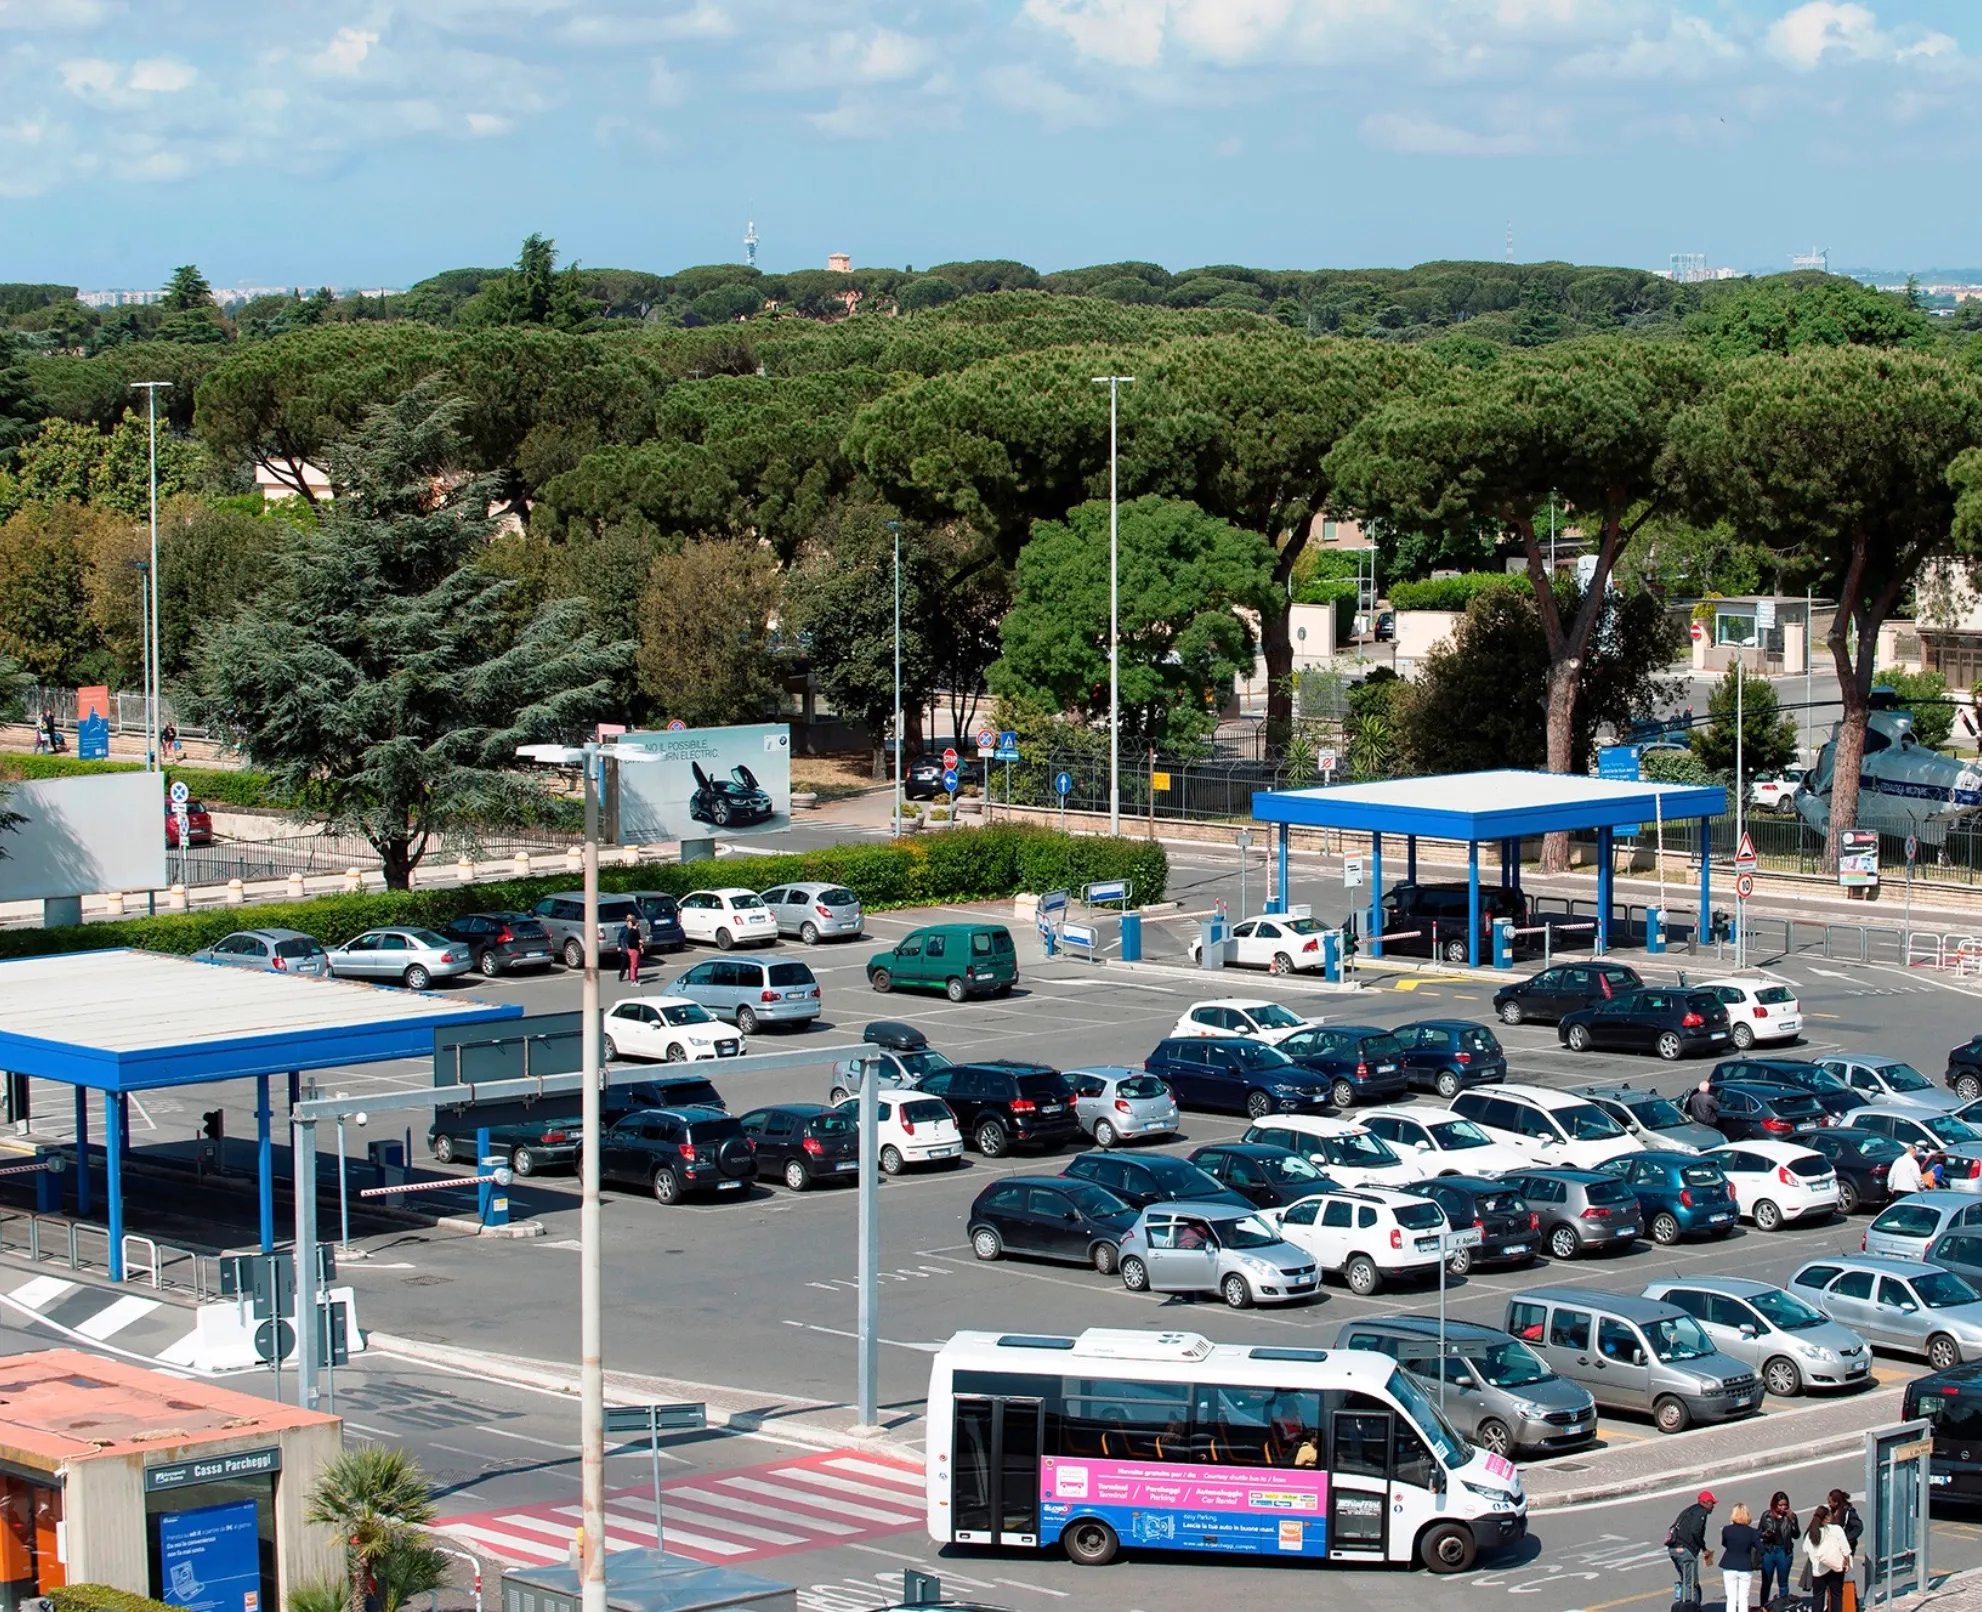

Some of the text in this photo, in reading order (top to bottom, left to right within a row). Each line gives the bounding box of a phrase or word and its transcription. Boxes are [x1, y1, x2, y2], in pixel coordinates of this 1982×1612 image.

[944, 755, 956, 764] STOP
[1742, 879, 1751, 892] 10
[194, 1453, 271, 1477] Cassa Parcheggi
[1098, 1482, 1129, 1491] Terminal
[1145, 1485, 1181, 1495] Parcheggi
[1099, 1491, 1238, 1505] Terminal Parking Car Rental
